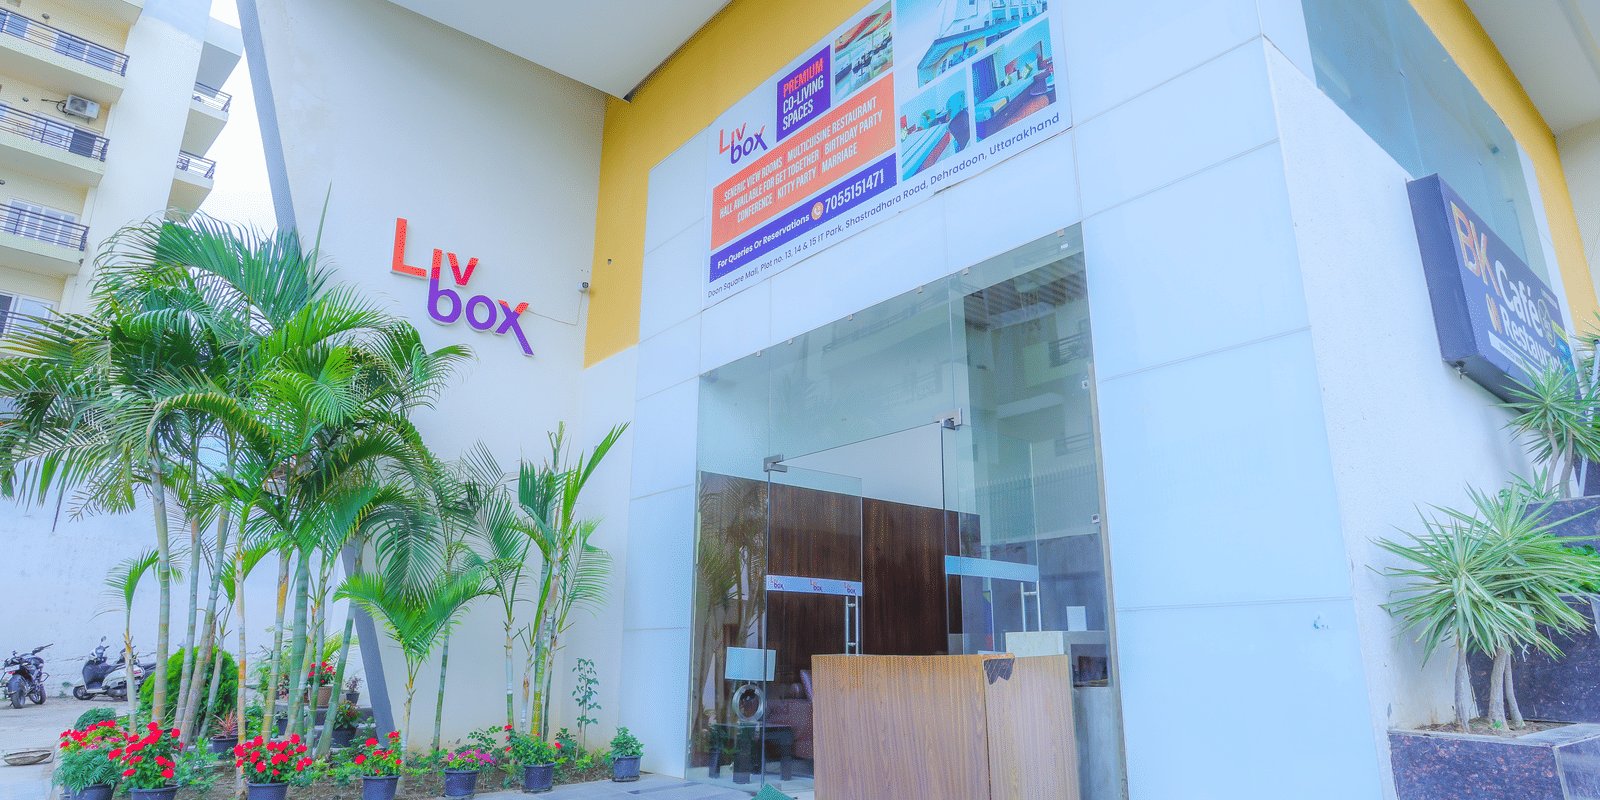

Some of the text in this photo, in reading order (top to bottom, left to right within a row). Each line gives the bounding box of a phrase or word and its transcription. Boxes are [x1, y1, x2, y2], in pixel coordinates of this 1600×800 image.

[782, 99, 814, 131] SPACES
[783, 57, 824, 98] PREMIUM
[783, 75, 824, 114] CO-LIVING
[720, 110, 883, 219] HALL AVAILABLE FOR GET TOGETHER BIRTHDAY PARTY
[730, 125, 768, 165] box
[746, 170, 761, 187] VIEW
[762, 157, 783, 178] ROOMS
[787, 125, 831, 163] MULTICUISINE
[832, 96, 877, 134] RESTAURANT
[708, 112, 1060, 298] Doon Square Mall, Plot no. 13, 14 & 15 IT Park, Shastradhara Road, Dehradoon, Uttarakhand
[717, 168, 885, 269] For Queries Or Reservations 7055151471
[737, 142, 858, 223] CONFERENCE KITTY PARTY MARRIAGE
[1450, 200, 1503, 299] BK
[426, 275, 535, 357] box
[1494, 259, 1544, 338] Café
